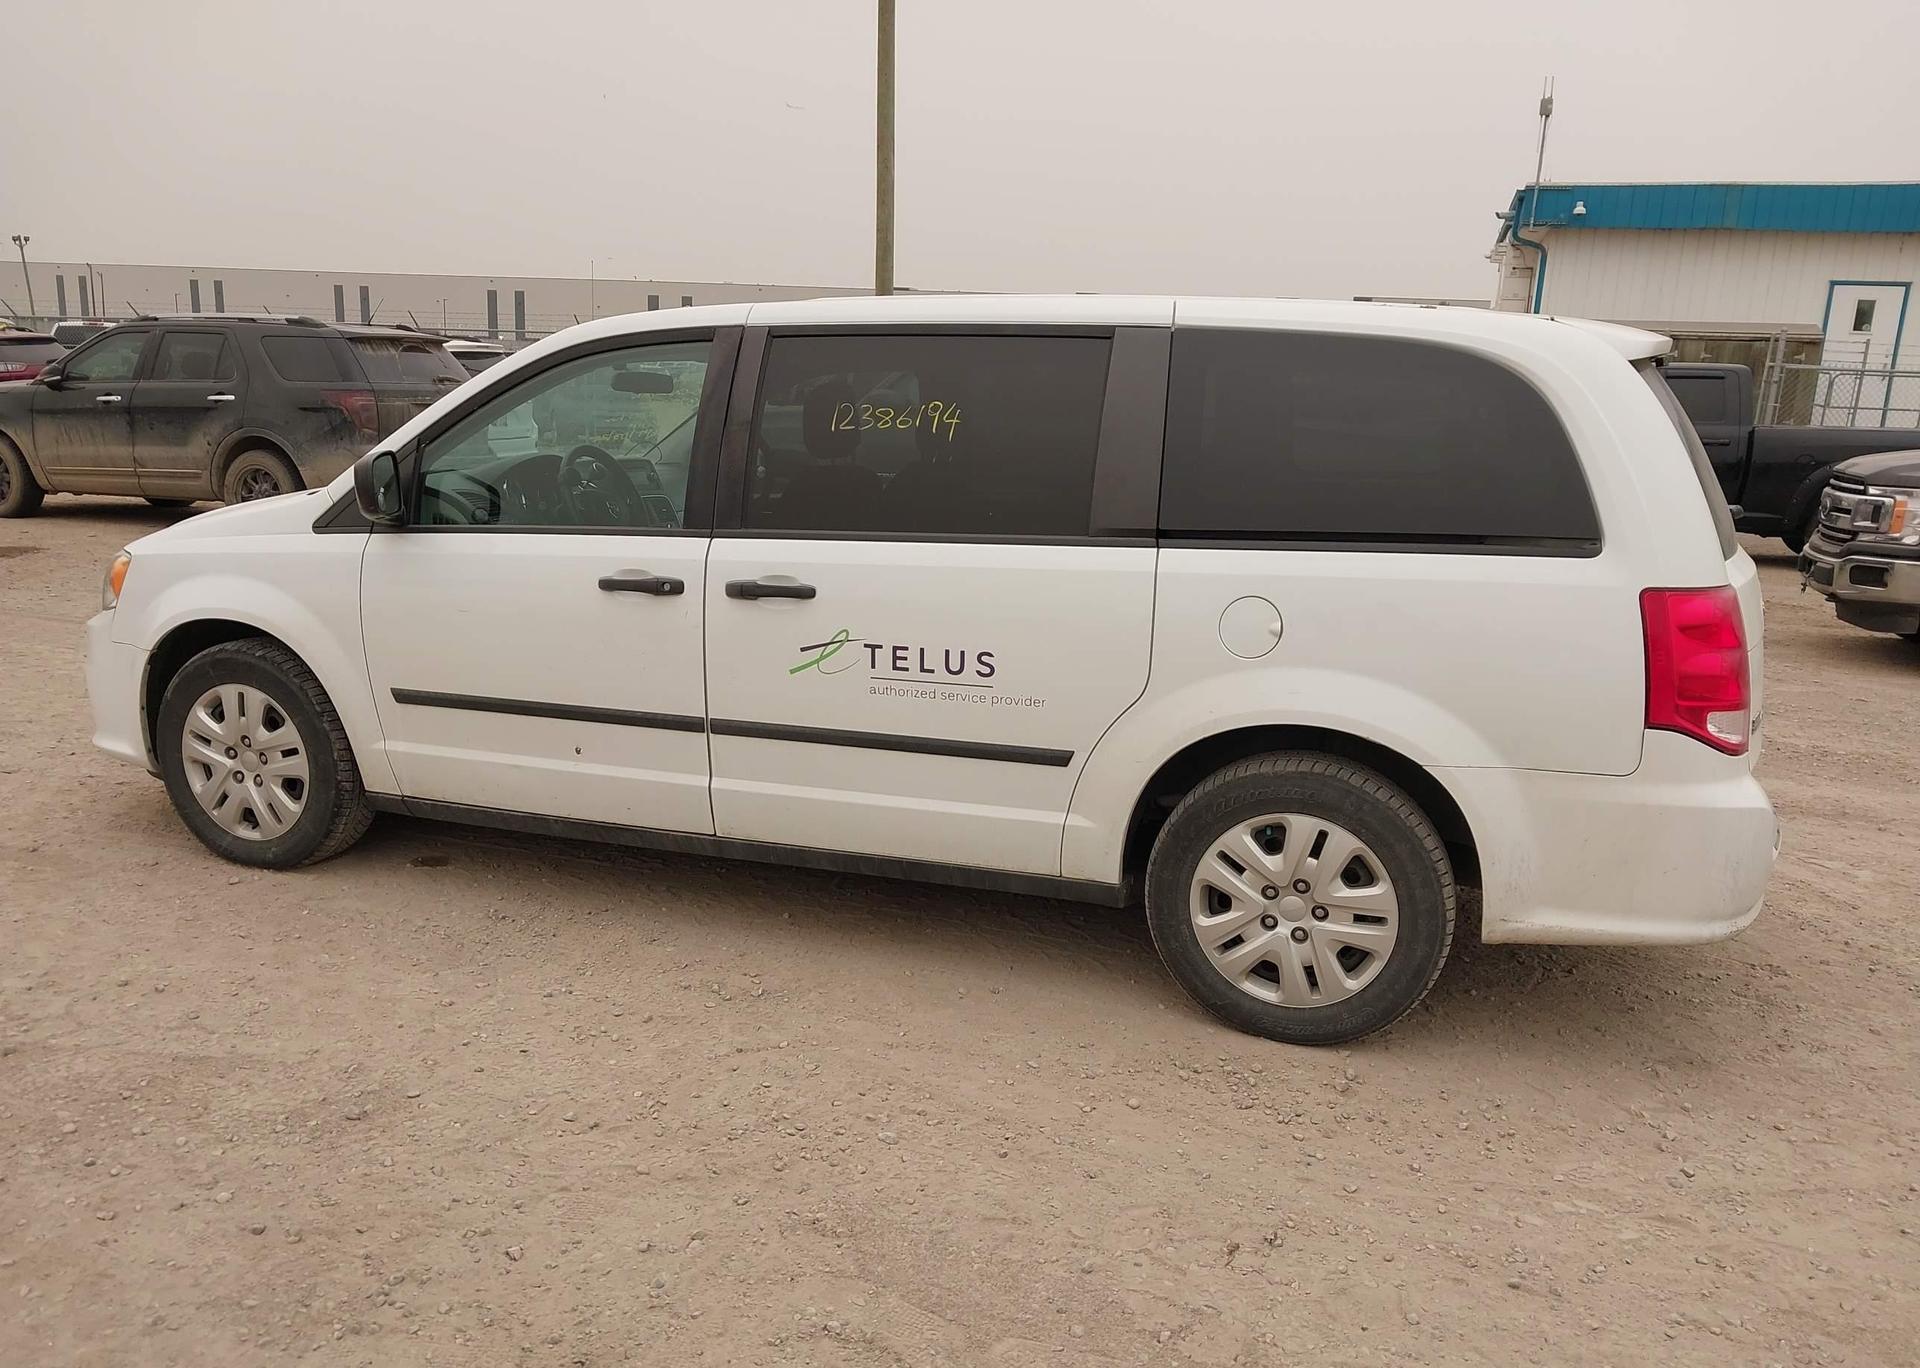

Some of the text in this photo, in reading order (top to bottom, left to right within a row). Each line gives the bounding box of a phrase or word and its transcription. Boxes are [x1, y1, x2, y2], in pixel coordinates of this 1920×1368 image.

[831, 401, 961, 442] 12386194
[863, 643, 996, 679] TELUS
[868, 684, 1047, 707] authorized service provider
